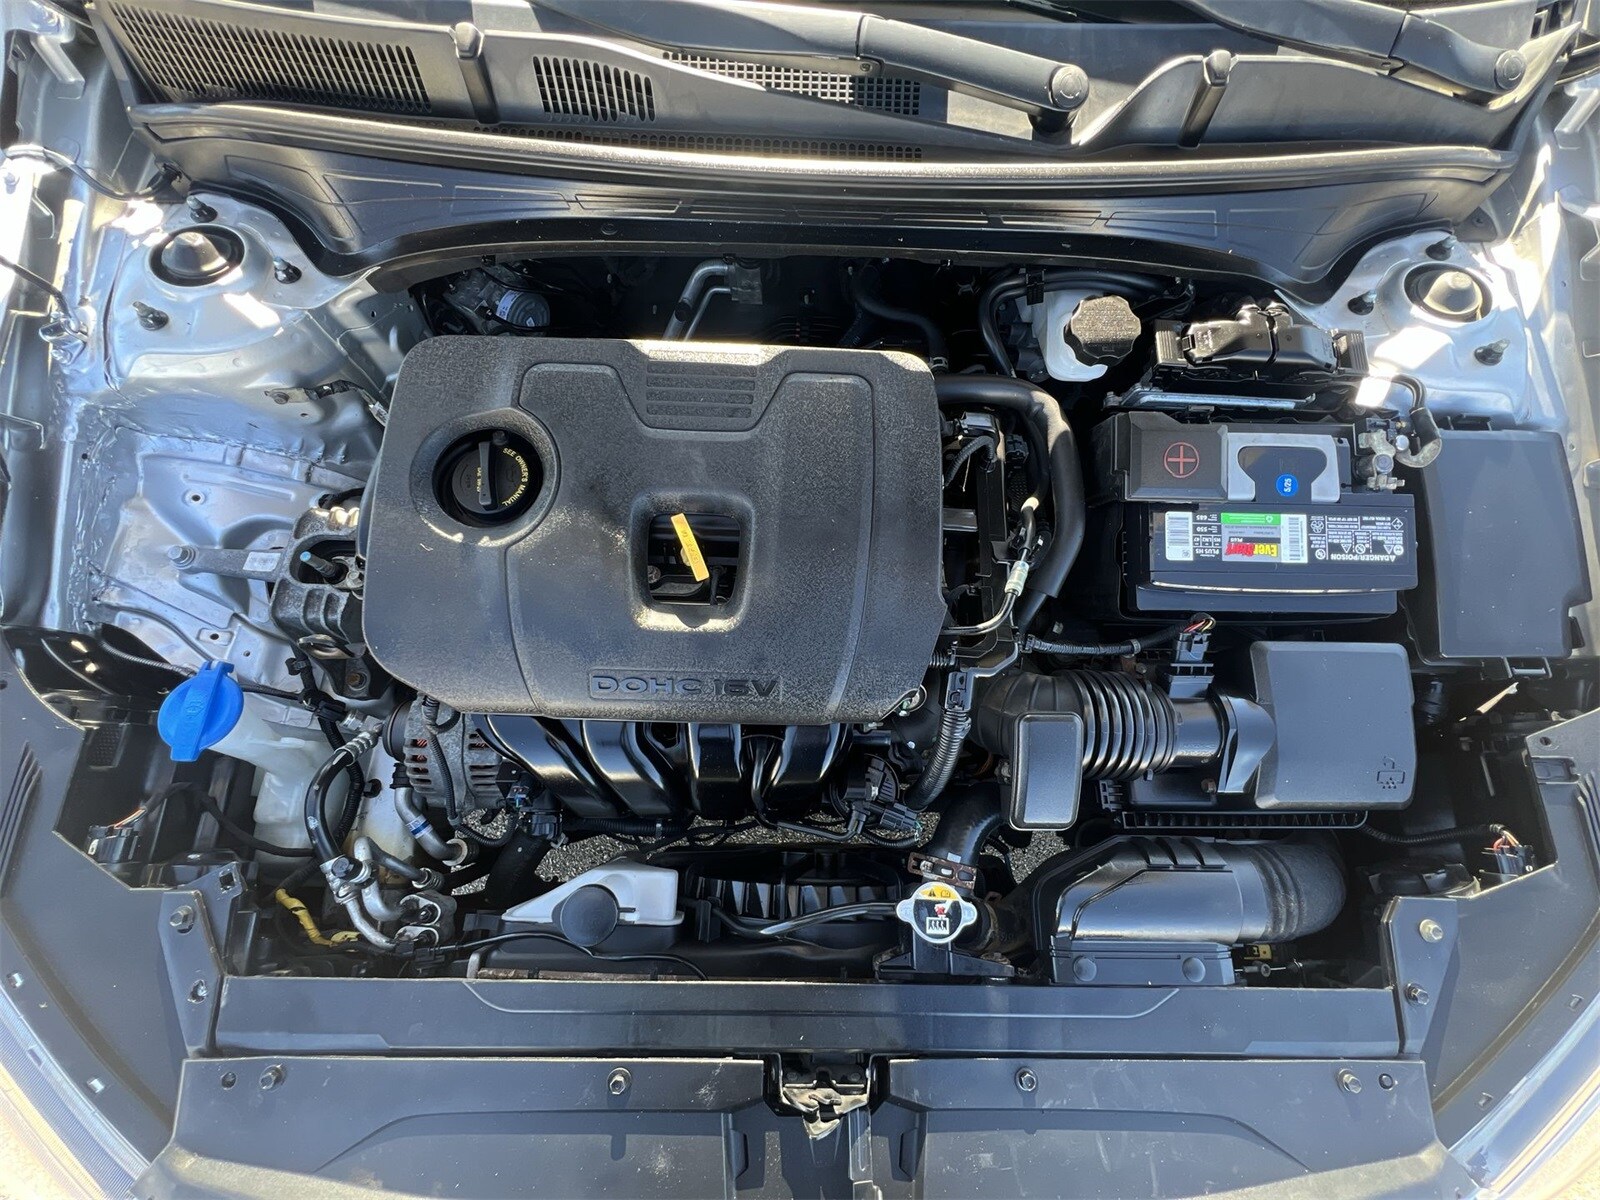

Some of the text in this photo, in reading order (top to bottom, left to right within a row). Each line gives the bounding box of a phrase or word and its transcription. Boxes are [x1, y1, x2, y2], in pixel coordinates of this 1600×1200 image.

[502, 447, 529, 507] SEE OWNER'S MANUAL
[1284, 478, 1292, 492] 5/25
[1226, 543, 1277, 557] EverStart
[592, 675, 780, 698] DOHC 16V
